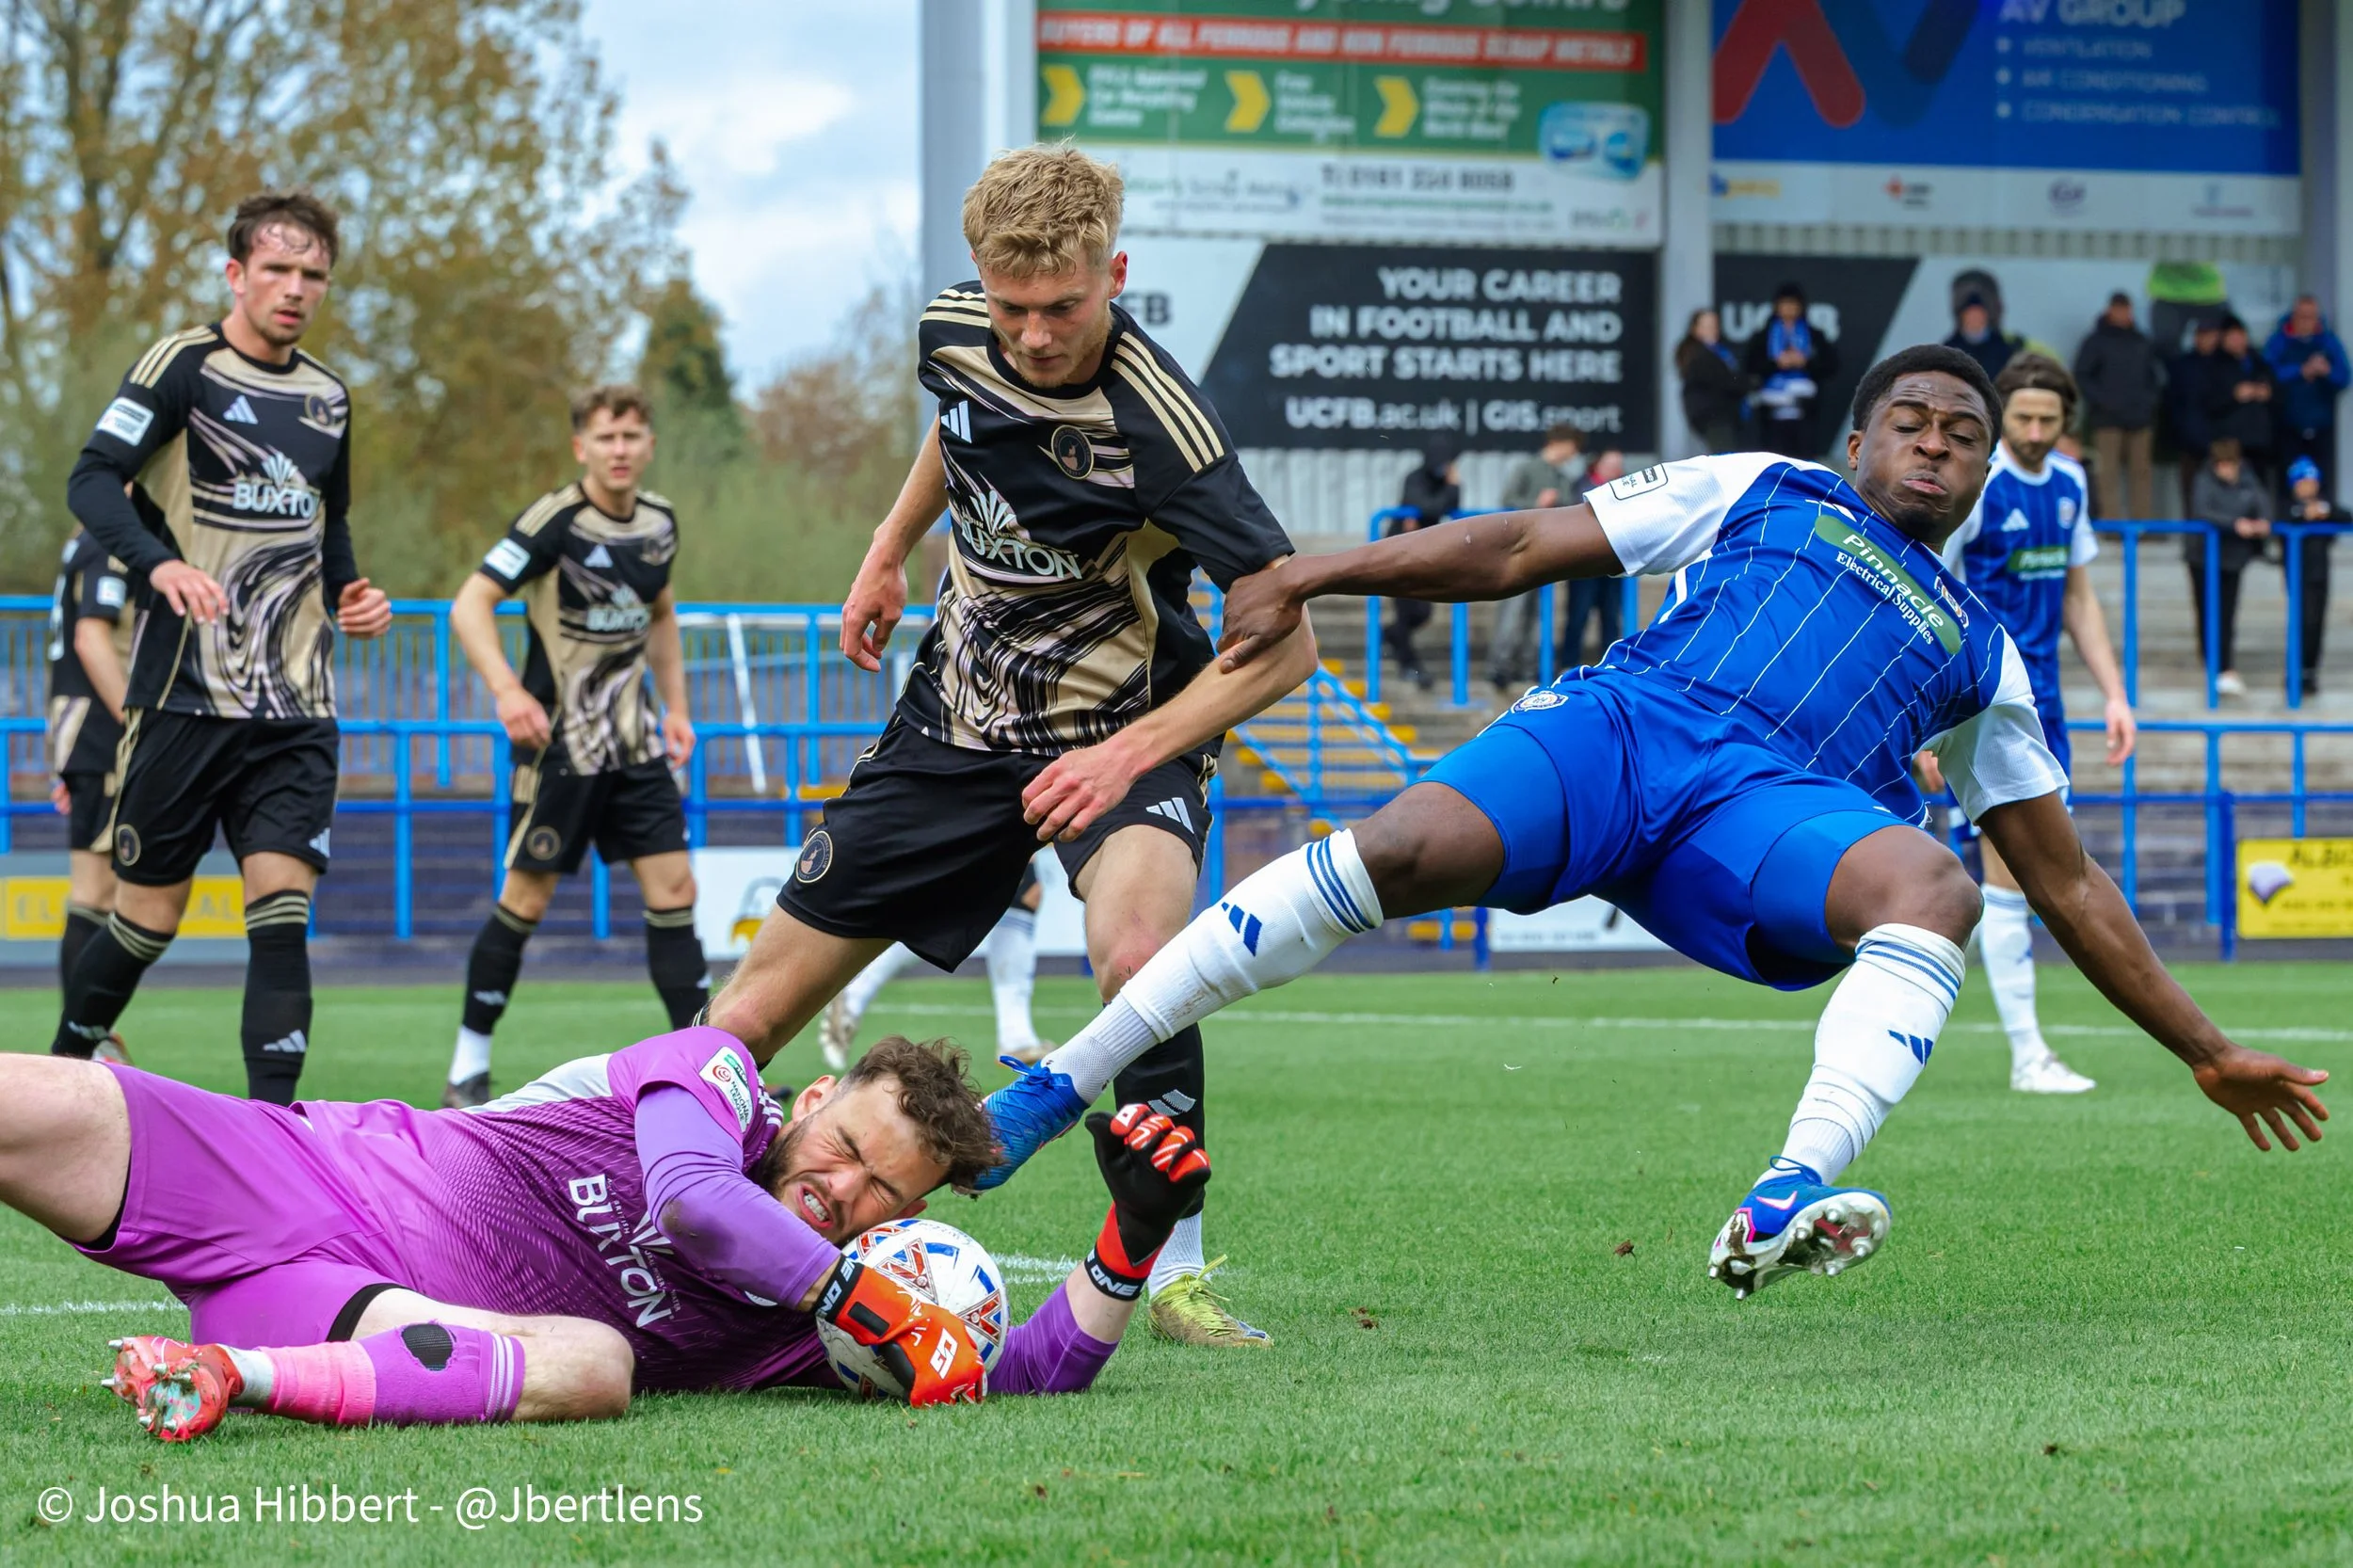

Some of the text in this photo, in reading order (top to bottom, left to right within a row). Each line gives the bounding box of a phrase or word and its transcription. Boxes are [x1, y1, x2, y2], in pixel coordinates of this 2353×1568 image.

[1999, 0, 2186, 27] AV GROUP
[1296, 25, 1337, 53] AND
[1554, 36, 1635, 65] METALS
[1378, 266, 1622, 303] YOUR CAREER
[1118, 291, 1174, 327] FB
[1309, 304, 1623, 344] IN FOOTBALL AND
[1270, 343, 1623, 382] SPORT STARTS HERE
[1286, 395, 1461, 431] UCFB.ac.uk
[232, 482, 322, 519] BUXTO
[1835, 552, 1935, 646] Electrical Supplies
[1843, 534, 1945, 629] Pinnacle
[568, 1174, 673, 1329] BUXTON
[1090, 1264, 1139, 1297] ONE
